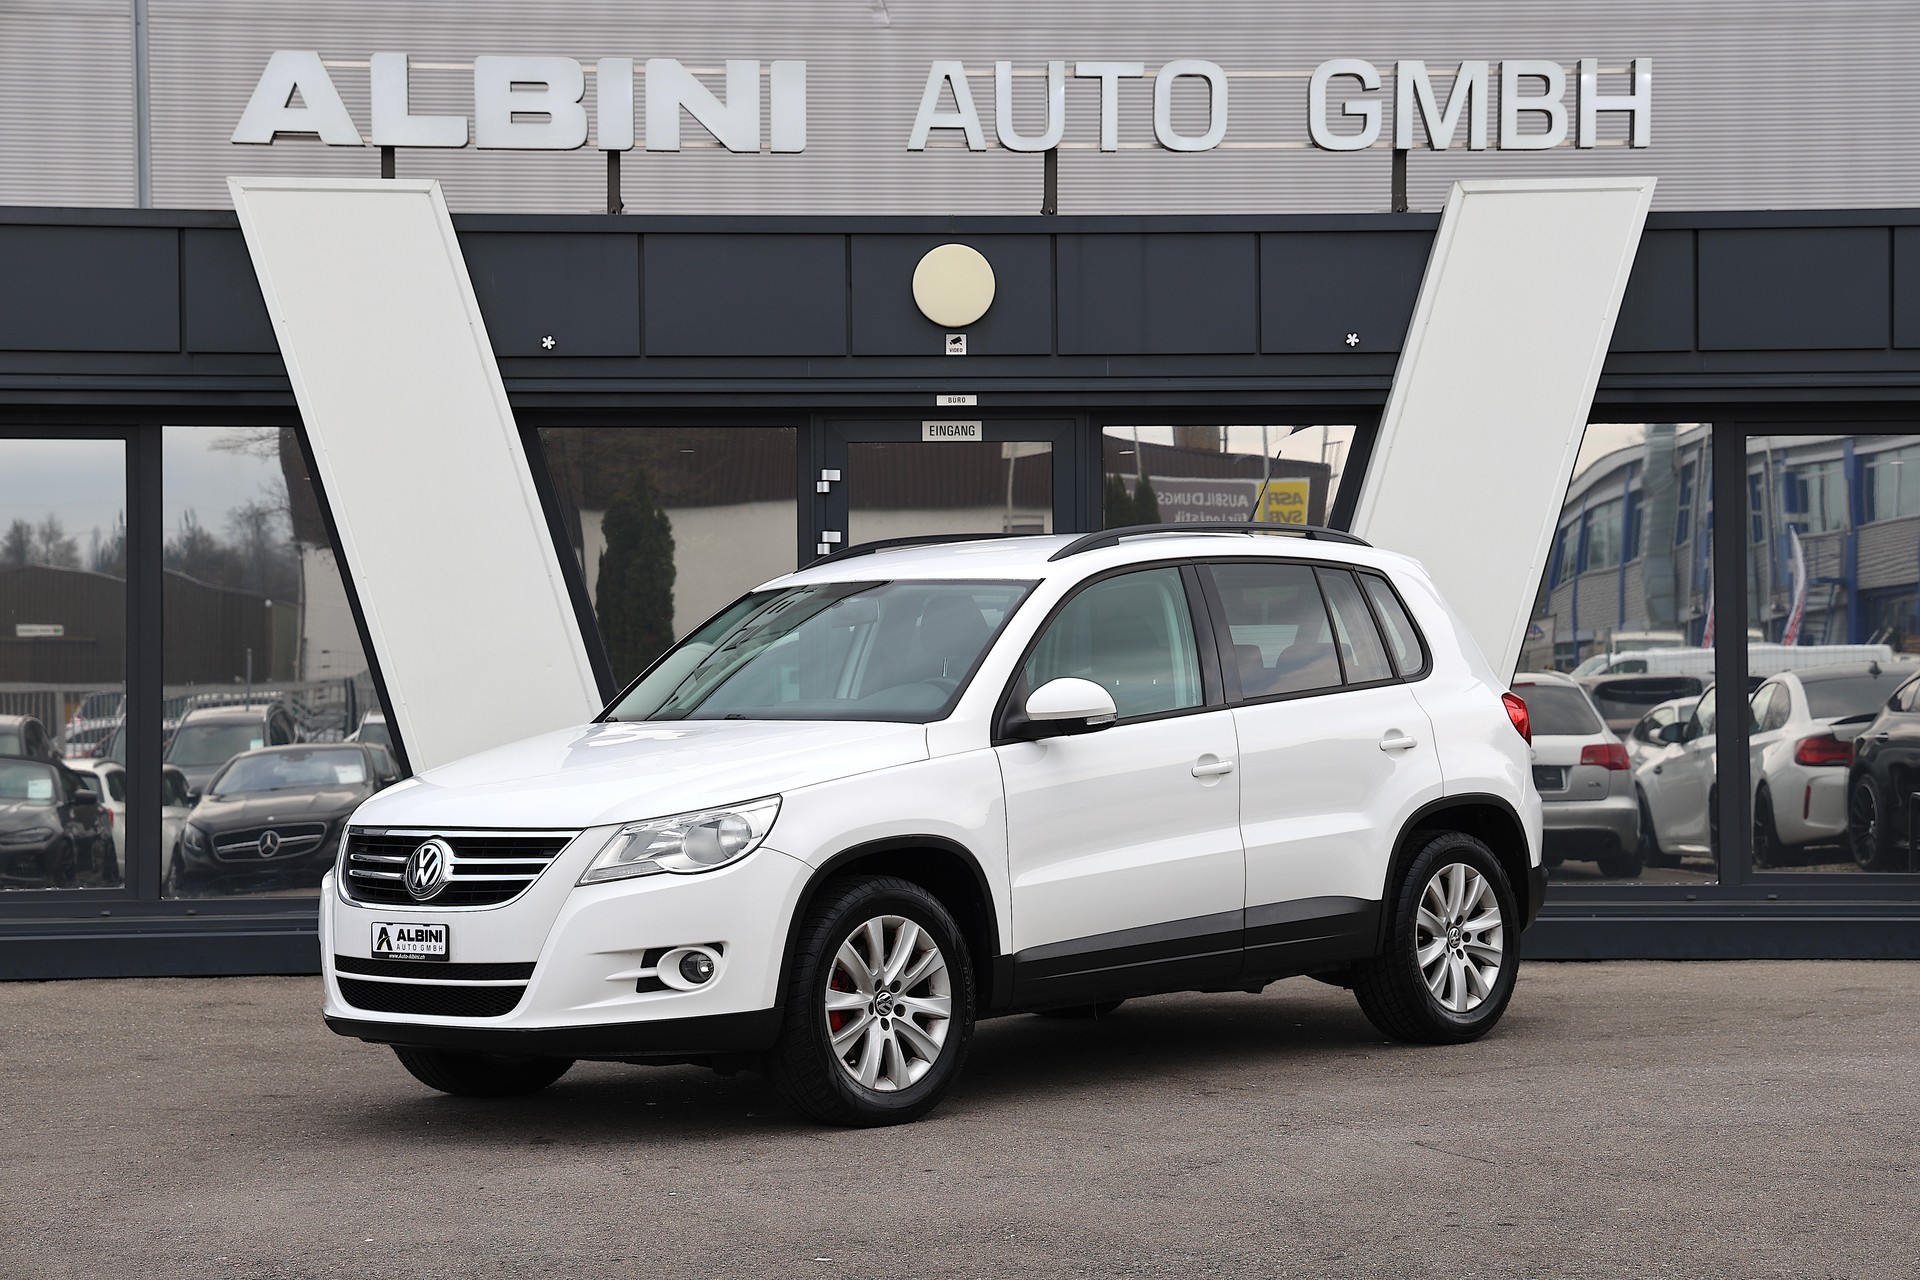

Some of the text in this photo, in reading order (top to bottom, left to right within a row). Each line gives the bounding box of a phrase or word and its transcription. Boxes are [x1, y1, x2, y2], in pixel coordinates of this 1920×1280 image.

[231, 50, 1653, 154] ALBINI AUTO GMBH
[929, 425, 975, 436] EINGANG
[396, 929, 443, 943] ALBINI
[397, 943, 443, 952] AUTO GMBH
